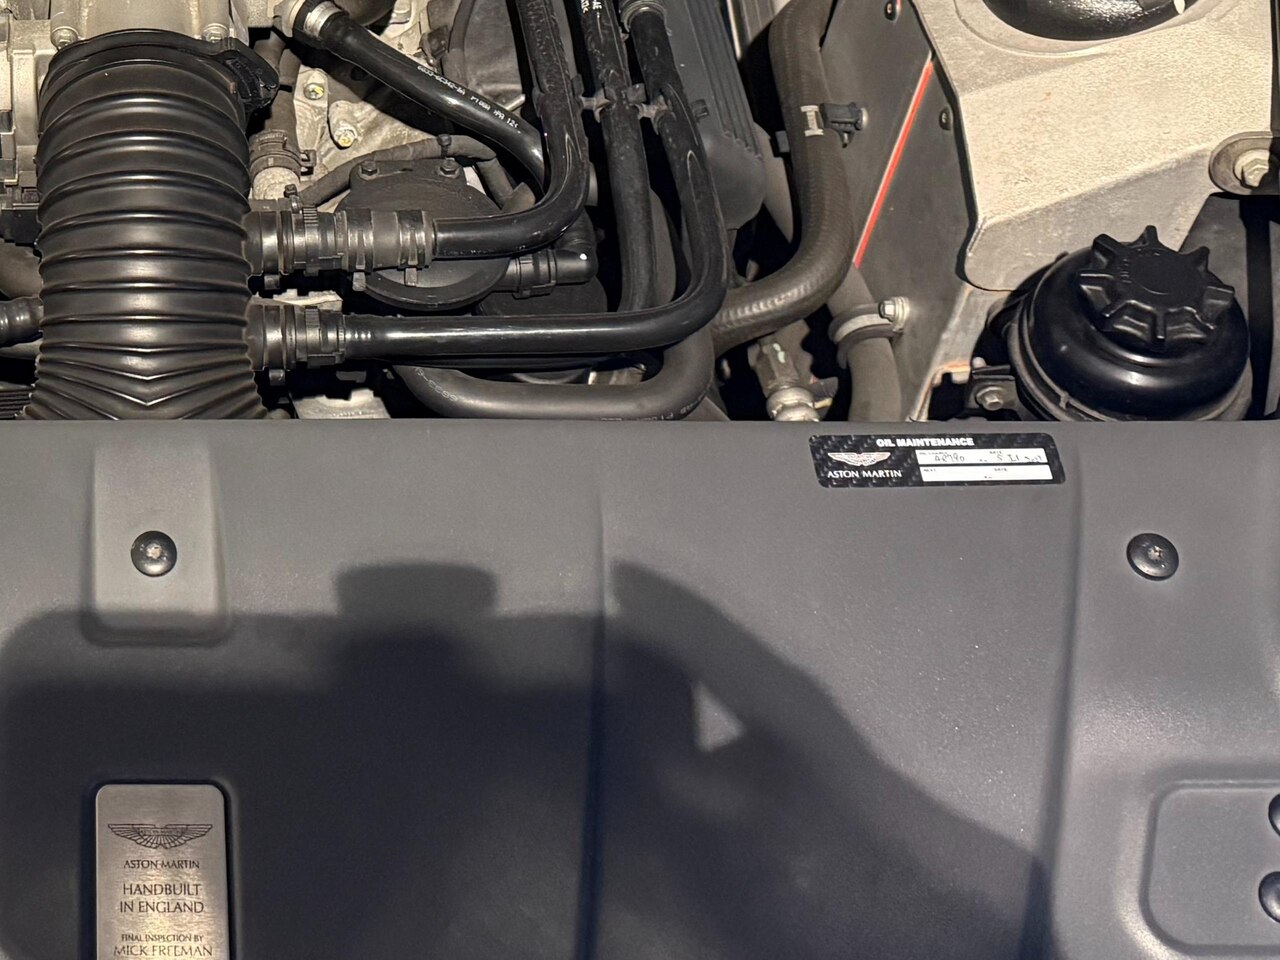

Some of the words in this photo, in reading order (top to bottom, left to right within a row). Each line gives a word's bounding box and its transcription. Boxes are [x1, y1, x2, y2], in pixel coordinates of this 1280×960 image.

[876, 438, 896, 447] OIL
[897, 437, 975, 447] MAINTENANCE
[827, 470, 860, 479] ASTON
[862, 469, 903, 478] MARTIN
[123, 859, 160, 869] ASTON
[161, 859, 200, 869] MARTIN
[123, 883, 202, 896] HANDBUILT
[120, 901, 133, 913] IN
[138, 901, 204, 913] ENGLAND
[121, 933, 142, 941] FINAL
[144, 933, 192, 941] INSPECTION
[194, 933, 204, 941] BY
[114, 945, 148, 957] MICK
